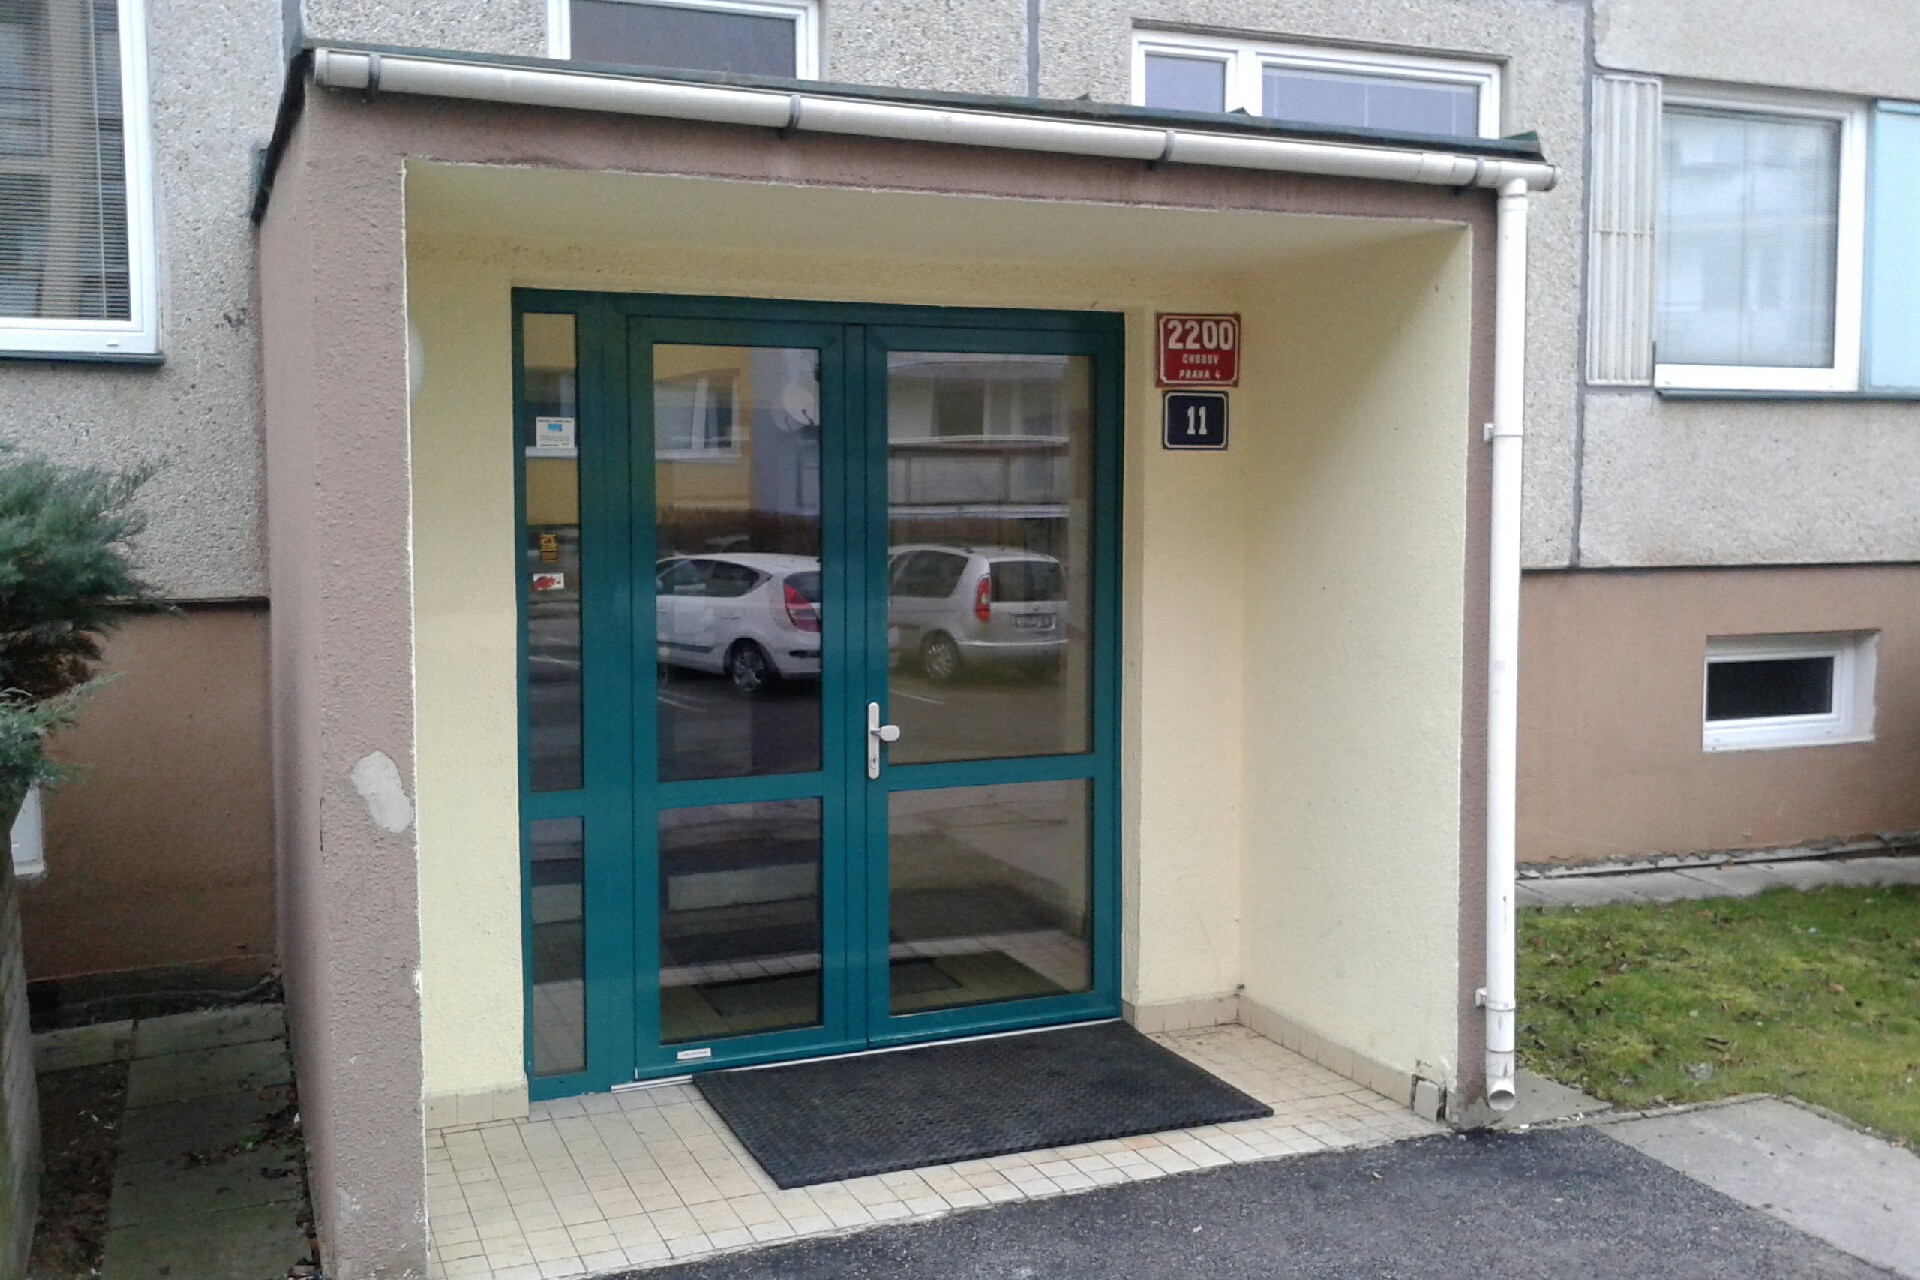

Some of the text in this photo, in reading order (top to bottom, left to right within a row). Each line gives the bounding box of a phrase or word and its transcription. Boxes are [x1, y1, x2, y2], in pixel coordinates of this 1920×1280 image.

[1168, 319, 1233, 350] 2200
[1178, 369, 1221, 379] PRAHA 4
[1186, 406, 1208, 435] 11
